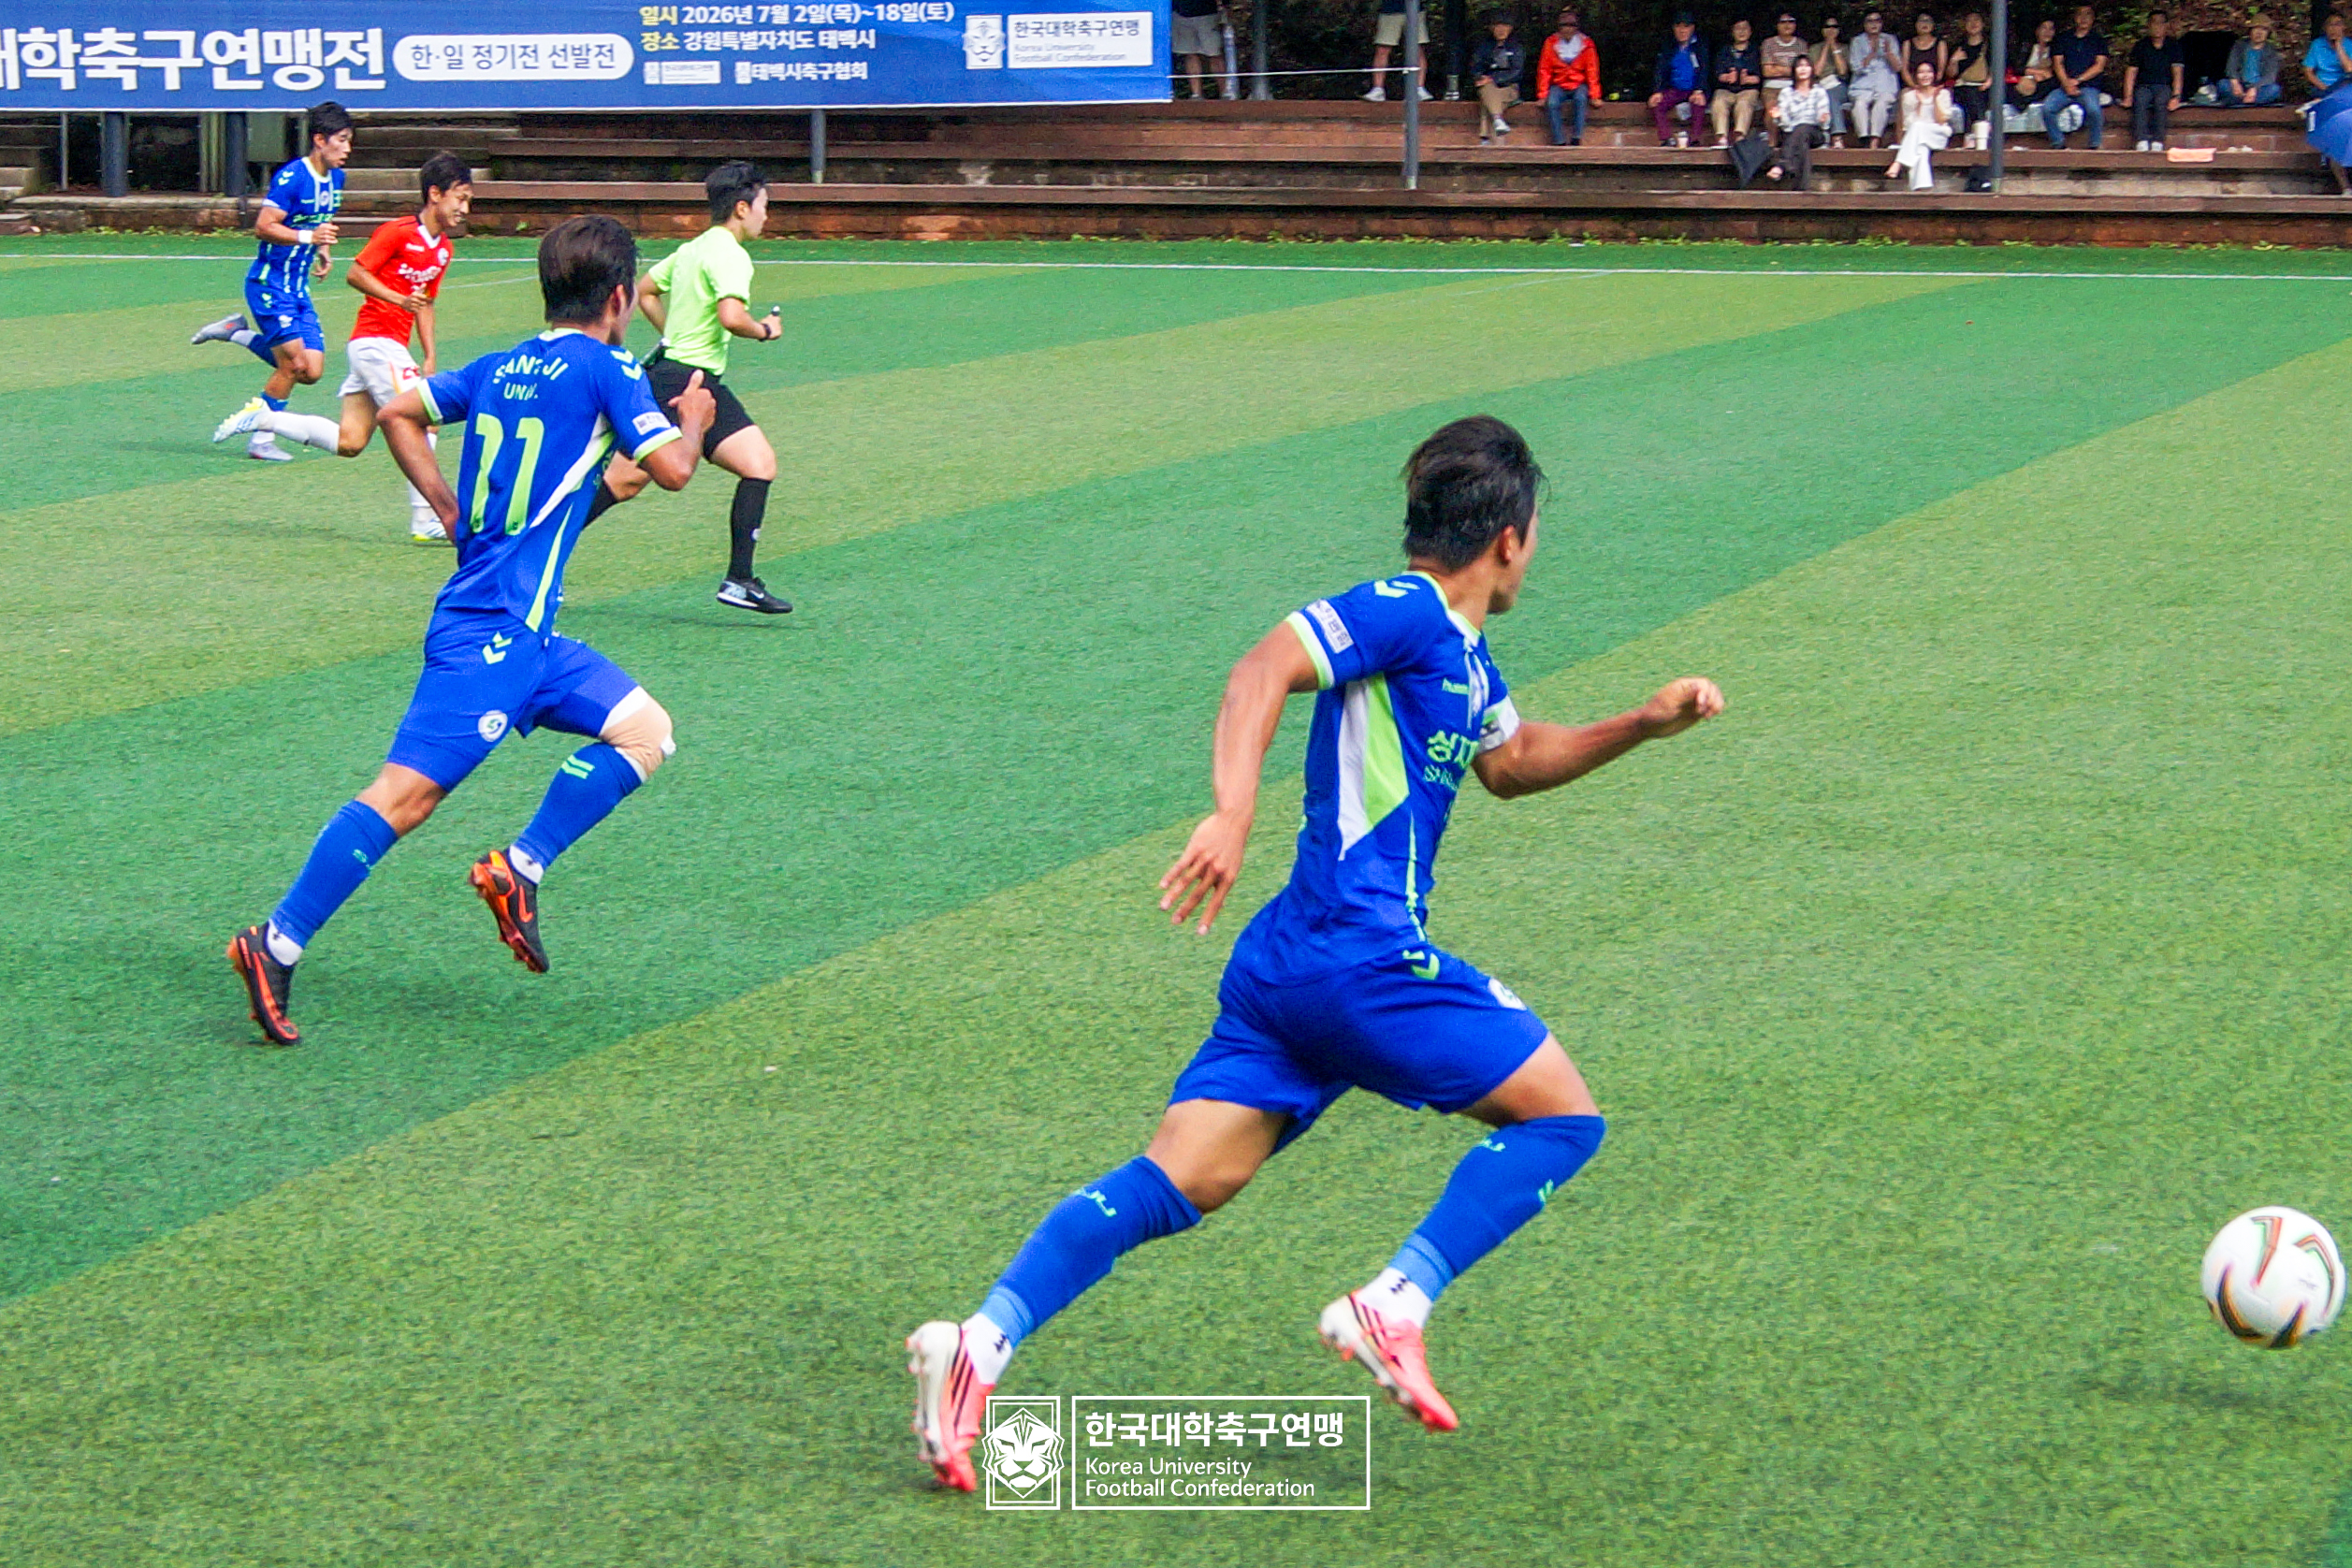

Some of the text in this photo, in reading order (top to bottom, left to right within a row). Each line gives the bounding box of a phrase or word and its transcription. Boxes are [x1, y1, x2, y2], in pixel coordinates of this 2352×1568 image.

[639, 2, 955, 25] 일시 2026년 7월 2일(목)~18일(토)
[641, 28, 876, 51] 장소 강원특별자치도 태백시
[1015, 19, 1140, 38] 한국대학축구연맹
[411, 43, 617, 70] 한·일 정기전 선발전
